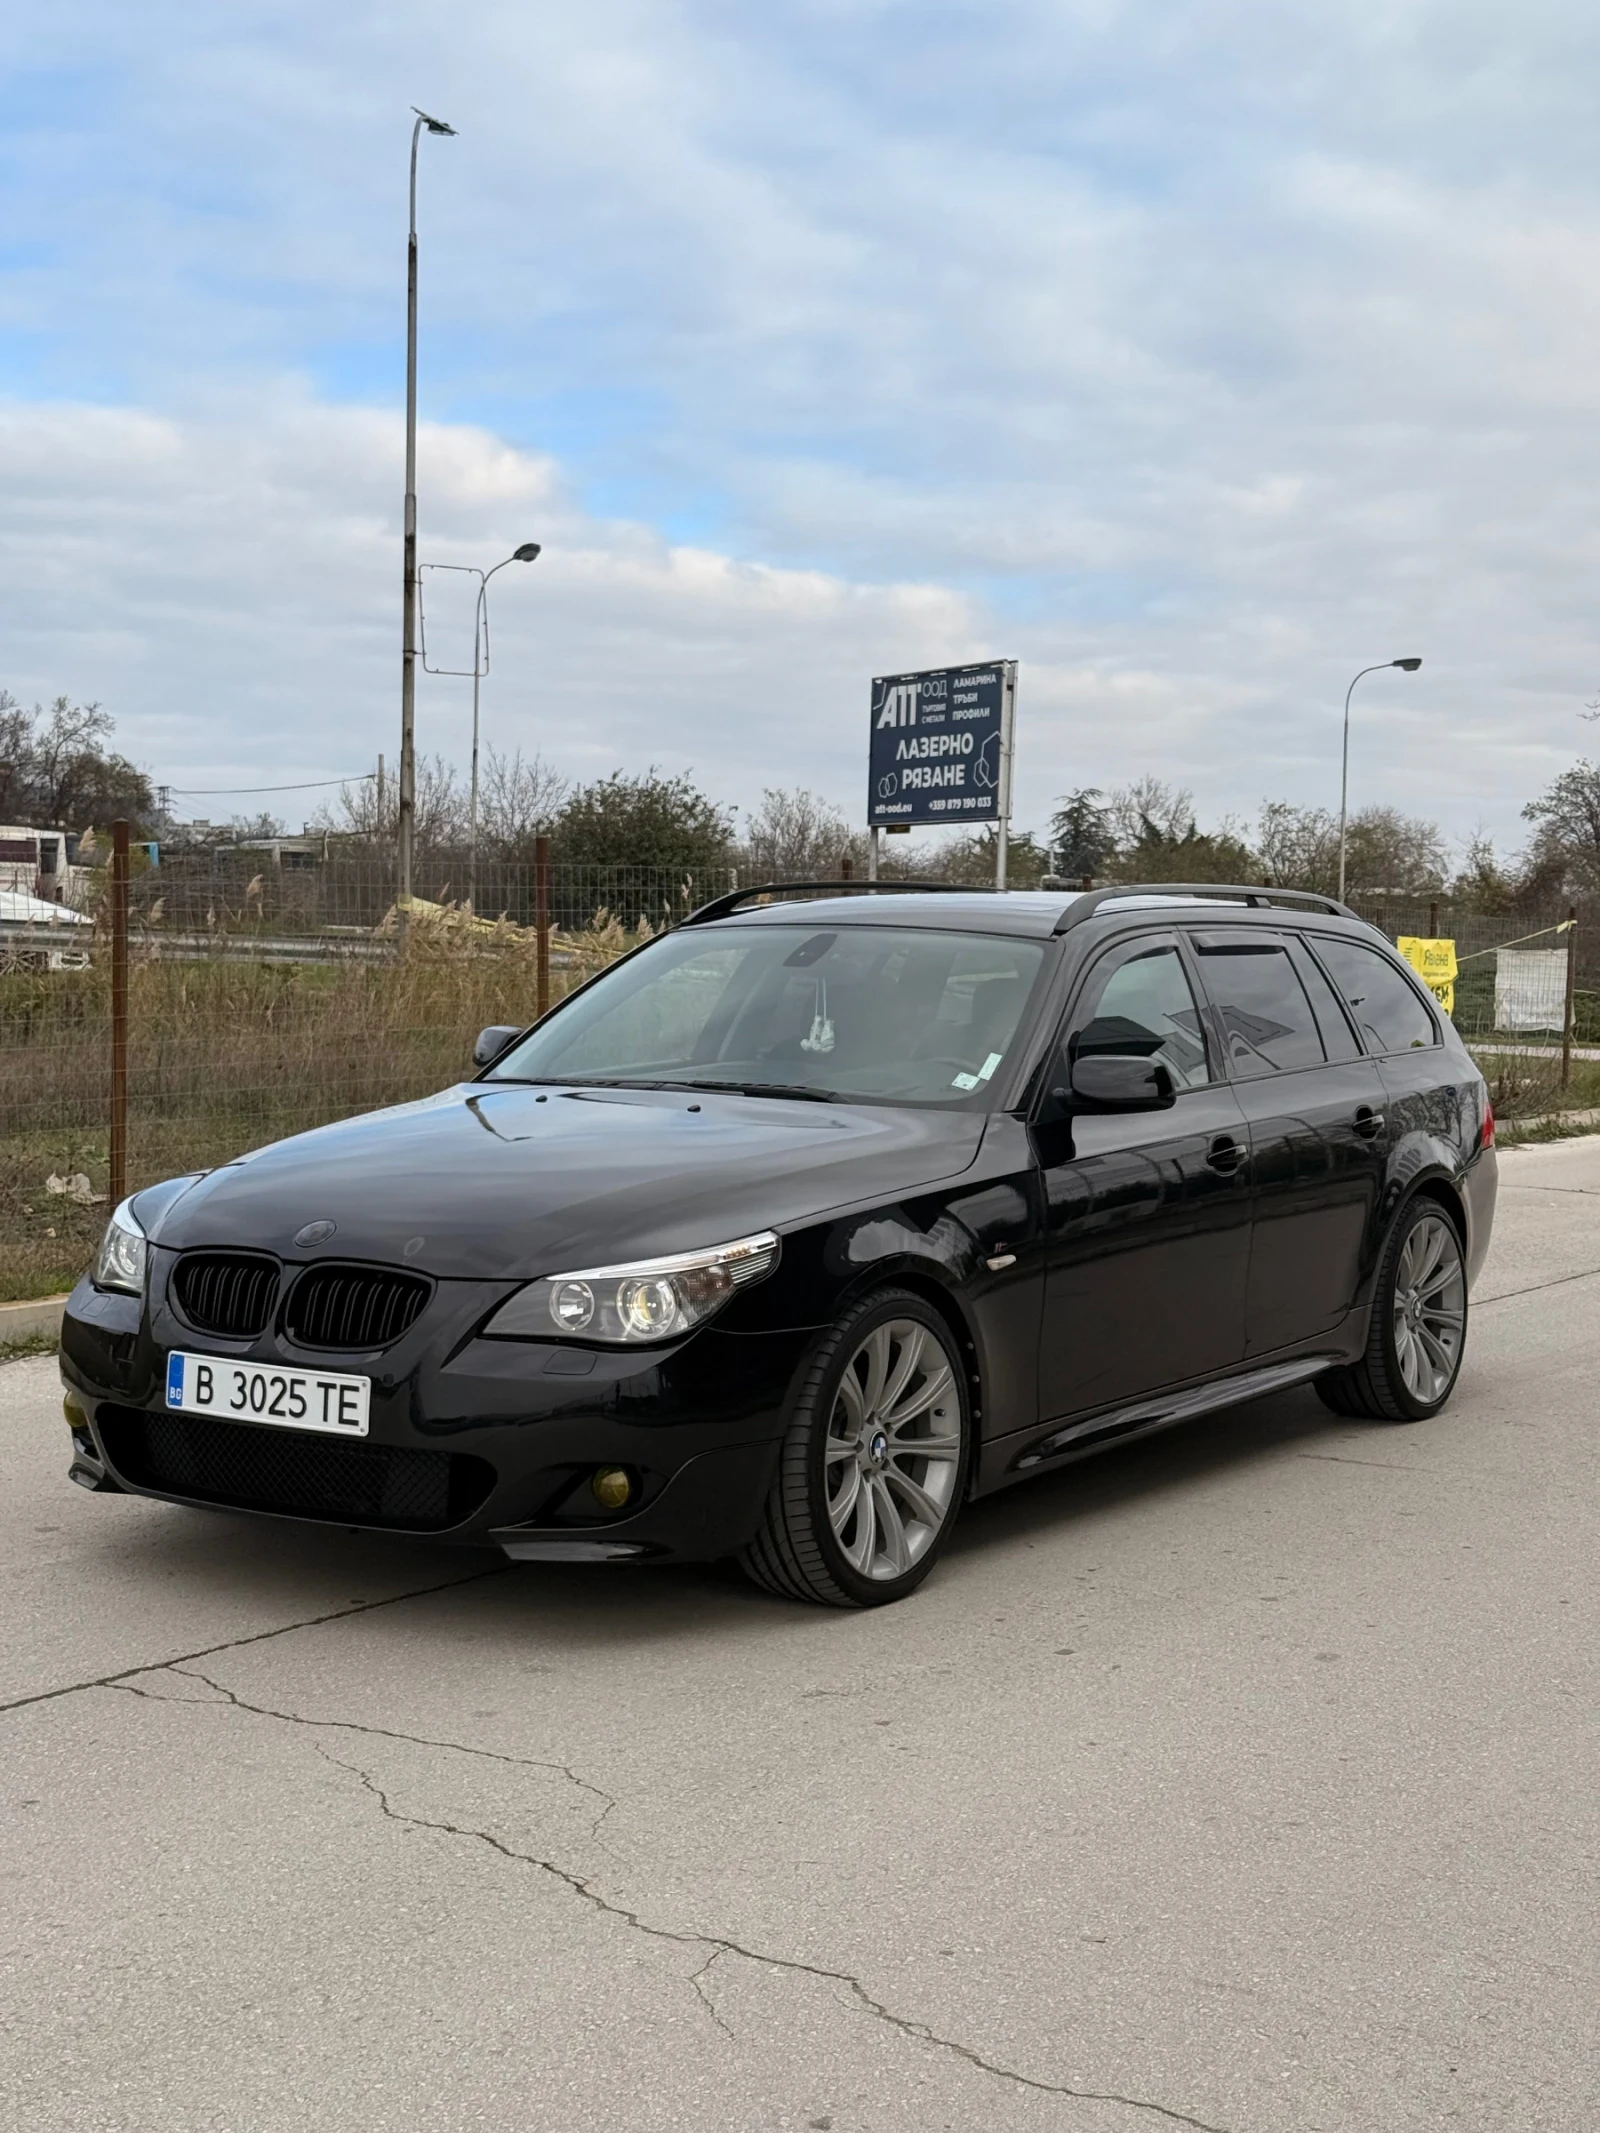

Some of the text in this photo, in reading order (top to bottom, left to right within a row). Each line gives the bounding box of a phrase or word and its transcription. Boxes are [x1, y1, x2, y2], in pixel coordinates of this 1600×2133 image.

[953, 674, 996, 688] ЛАМАРИНА
[922, 680, 948, 699] ООД
[952, 692, 978, 705] ТРЪБИ
[952, 707, 990, 721] ПРОФИЛИ
[895, 732, 974, 761] ЛАЗЕРНО
[901, 764, 966, 790] РЯЗАНЕ
[928, 796, 992, 810] +359 879 190 033
[169, 1387, 182, 1400] BG
[196, 1365, 360, 1426] B 3025 TE
